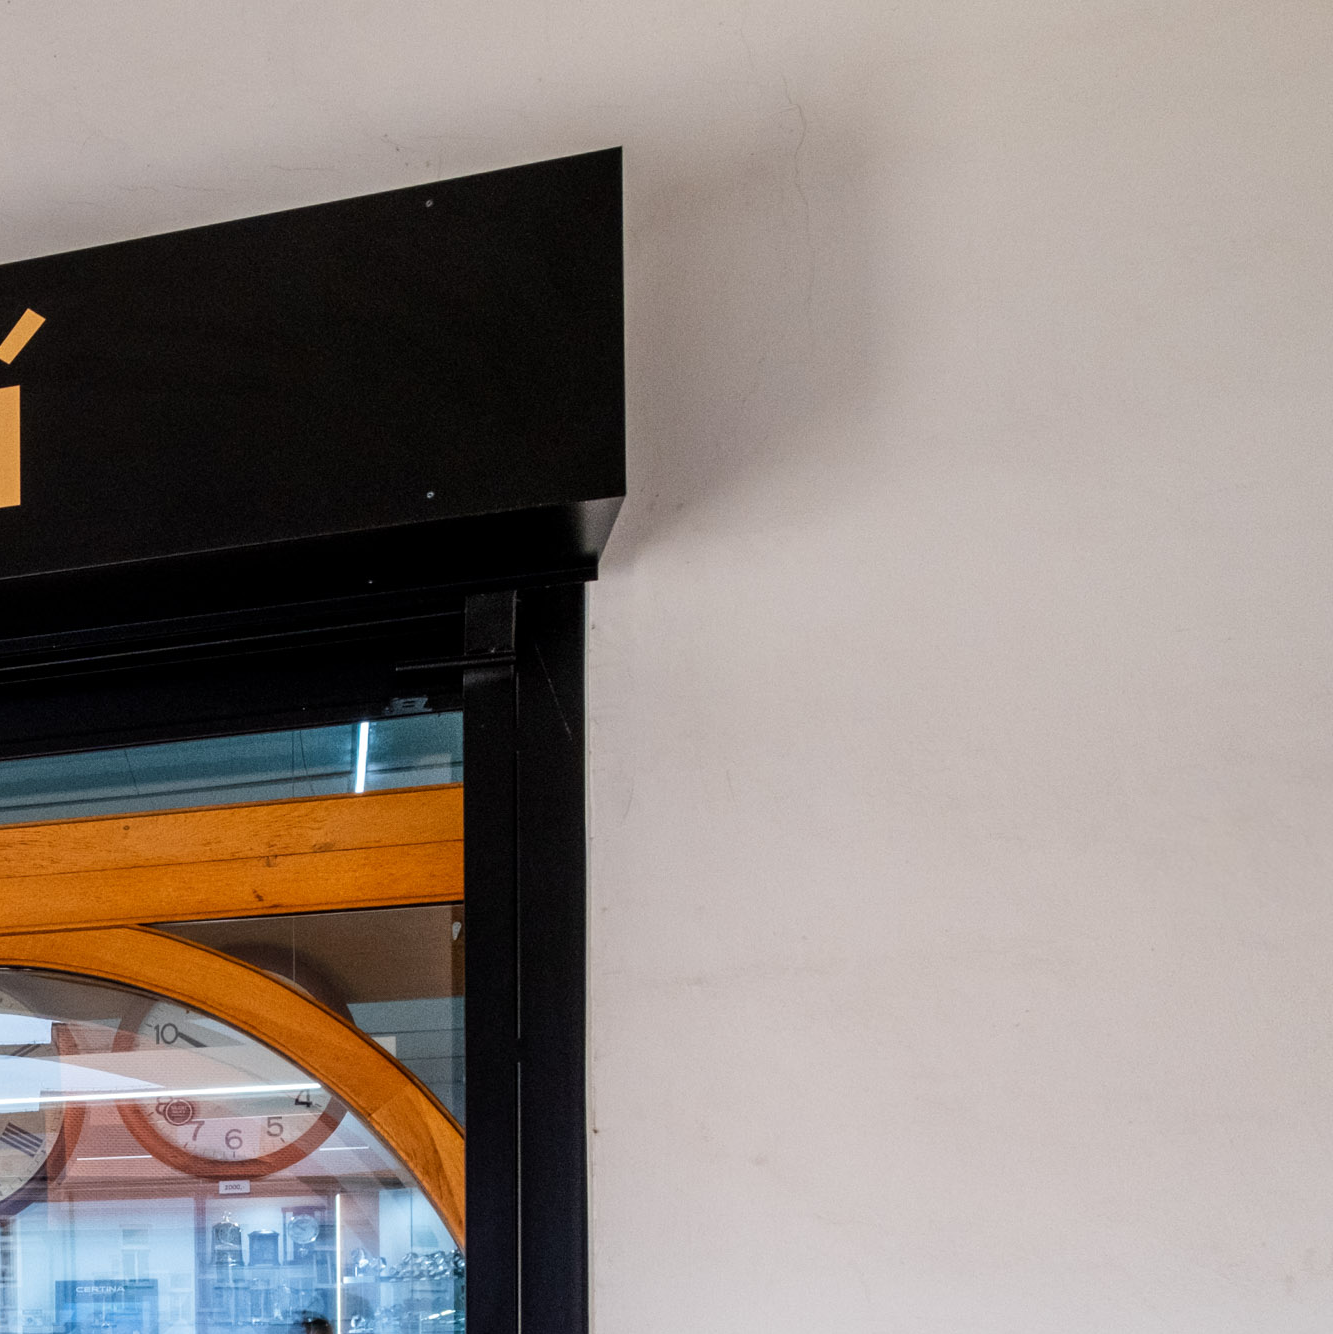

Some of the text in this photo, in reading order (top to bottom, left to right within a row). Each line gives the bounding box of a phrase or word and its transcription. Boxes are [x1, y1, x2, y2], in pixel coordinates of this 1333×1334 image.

[154, 1023, 178, 1045] 10
[294, 1089, 313, 1108] 4
[189, 1121, 205, 1141] 7
[267, 1116, 283, 1137] 5
[225, 1128, 243, 1150] 6
